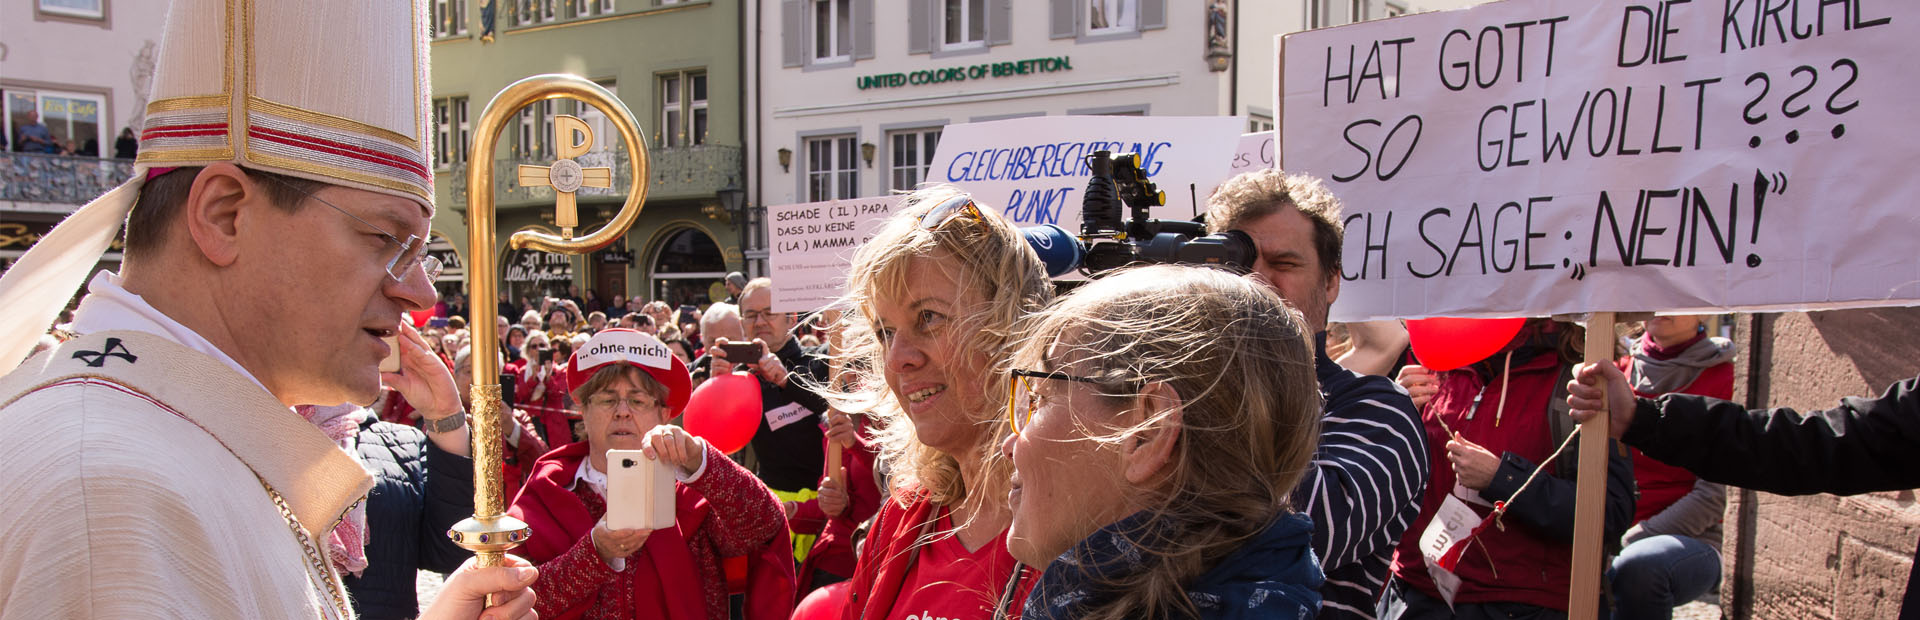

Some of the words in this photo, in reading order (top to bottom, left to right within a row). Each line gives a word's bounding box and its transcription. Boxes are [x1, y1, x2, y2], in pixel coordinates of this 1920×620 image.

[1324, 37, 1415, 107] HAT
[1439, 16, 1569, 91] GOTT
[1617, 0, 1692, 68] DIE
[857, 73, 906, 90] UNITED
[908, 67, 966, 86] COLORS
[968, 64, 989, 80] OF
[1332, 114, 1423, 183] SO
[776, 208, 820, 221] SCHADE
[861, 203, 889, 214] PAPA
[1003, 187, 1075, 225] PUNKT
[777, 226, 804, 236] DASS
[808, 225, 821, 234] DU
[825, 221, 856, 232] KEINE
[812, 237, 856, 249] MAMMA
[629, 343, 668, 359] mich!
